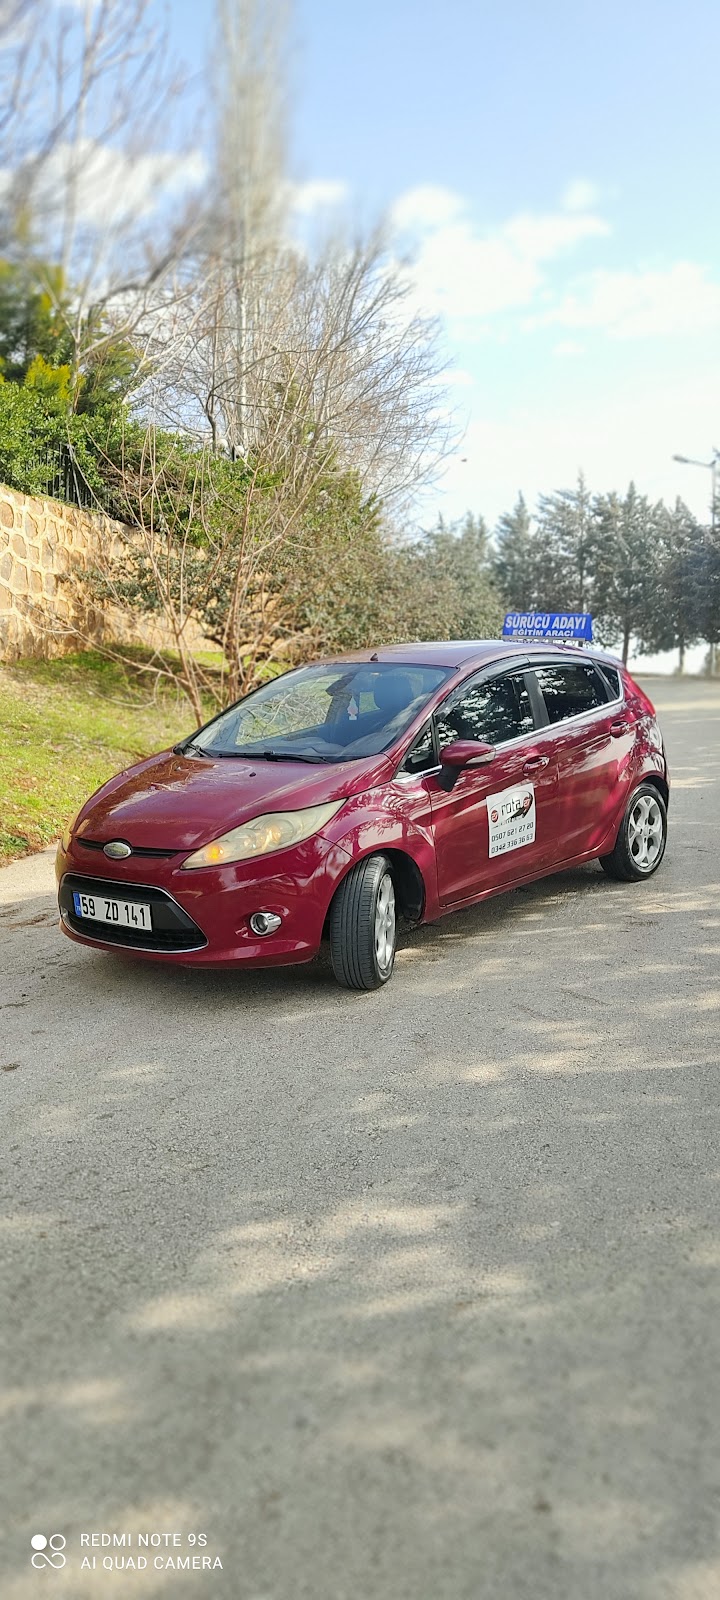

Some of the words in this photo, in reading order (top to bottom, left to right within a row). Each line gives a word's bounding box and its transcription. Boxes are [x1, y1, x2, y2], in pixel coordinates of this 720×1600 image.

[505, 613, 550, 629] SÜRÜCÜ
[552, 616, 586, 629] ADAYI
[512, 628, 543, 636] EĞİTİM
[501, 798, 521, 816] rota
[491, 831, 506, 842] 0507
[518, 825, 525, 833] 27
[82, 897, 95, 917] 59
[104, 901, 119, 921] ZD
[124, 904, 146, 927] 141
